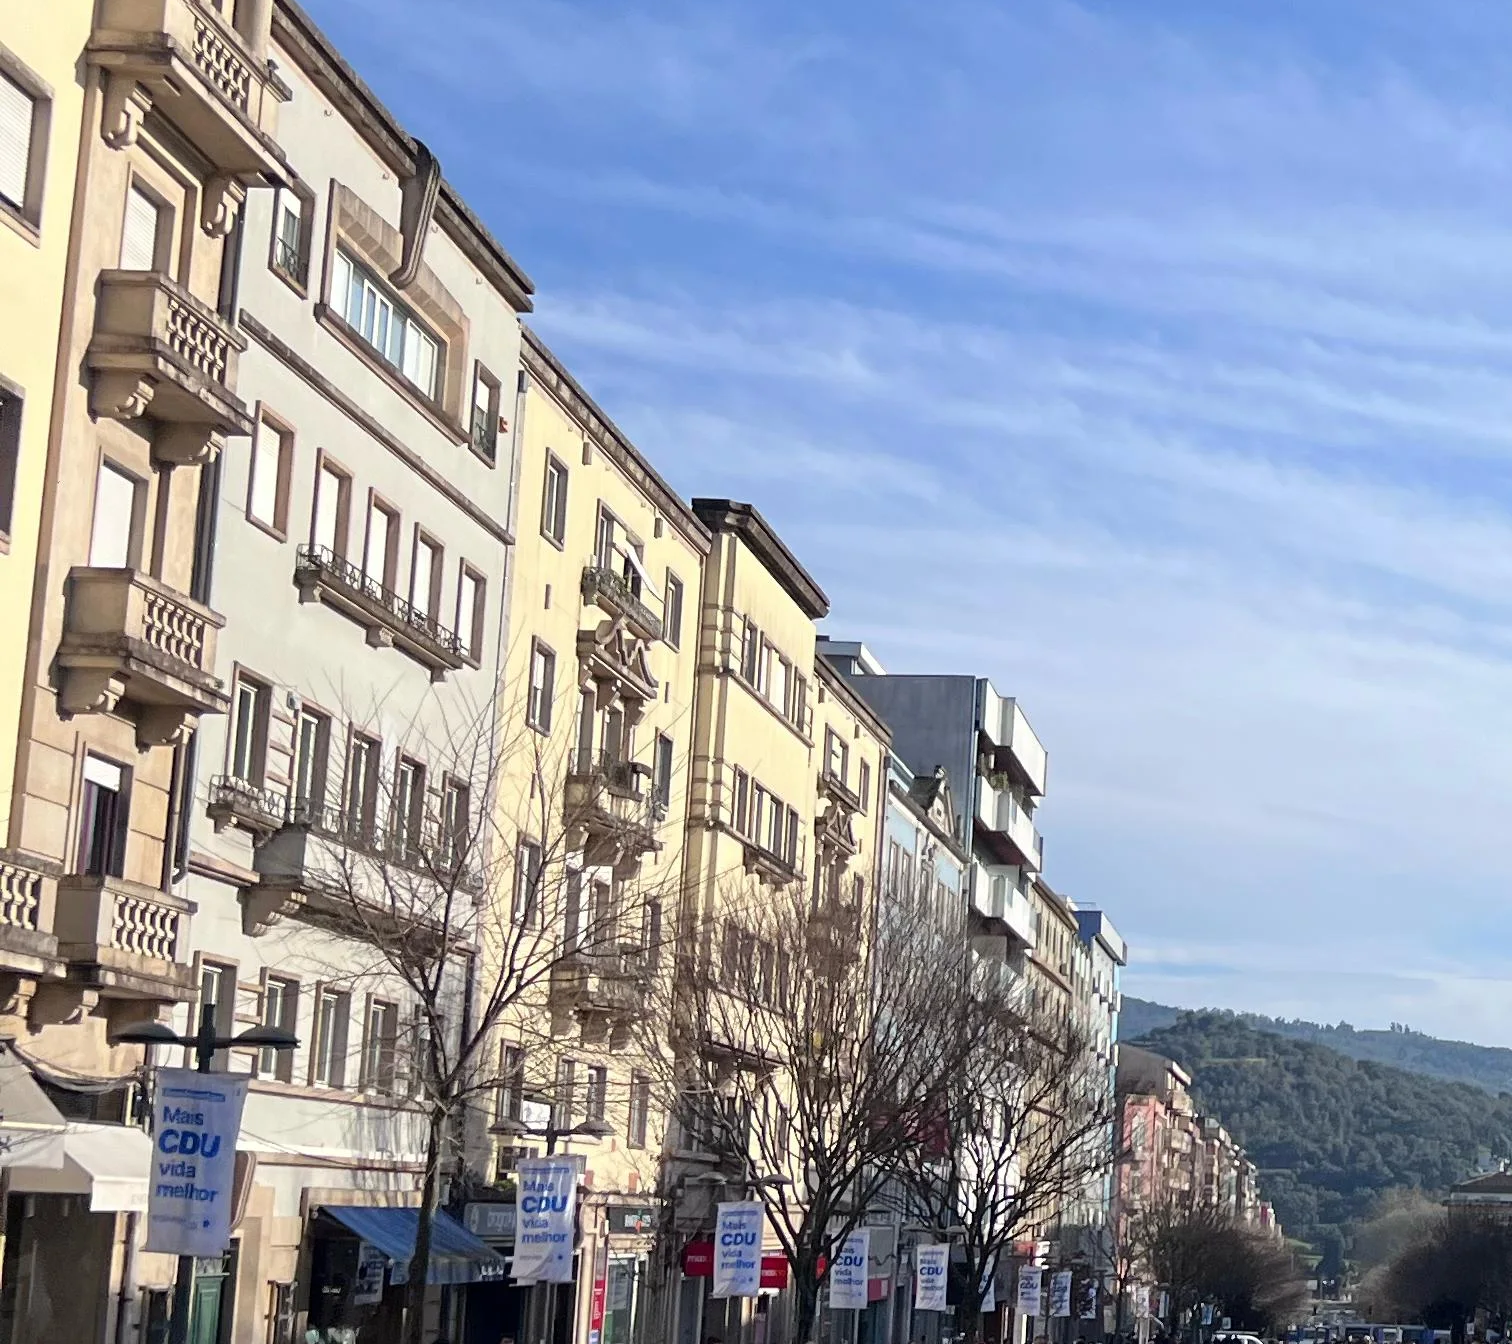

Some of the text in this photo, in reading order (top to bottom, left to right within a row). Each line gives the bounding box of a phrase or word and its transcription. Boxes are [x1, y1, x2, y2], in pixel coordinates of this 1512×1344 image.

[163, 1106, 204, 1126] Mais
[158, 1129, 221, 1158] CDU
[159, 1160, 196, 1178] vida
[523, 1180, 554, 1192] Mais
[156, 1182, 219, 1203] melhor
[521, 1196, 567, 1213] CDU
[522, 1218, 549, 1229] vida
[722, 1220, 746, 1230] Mais
[522, 1232, 568, 1244] melhor
[721, 1232, 757, 1246] CDU
[722, 1250, 742, 1258] vida
[721, 1260, 756, 1270] melhor
[835, 1256, 863, 1267] CDU
[920, 1266, 943, 1276] CDU
